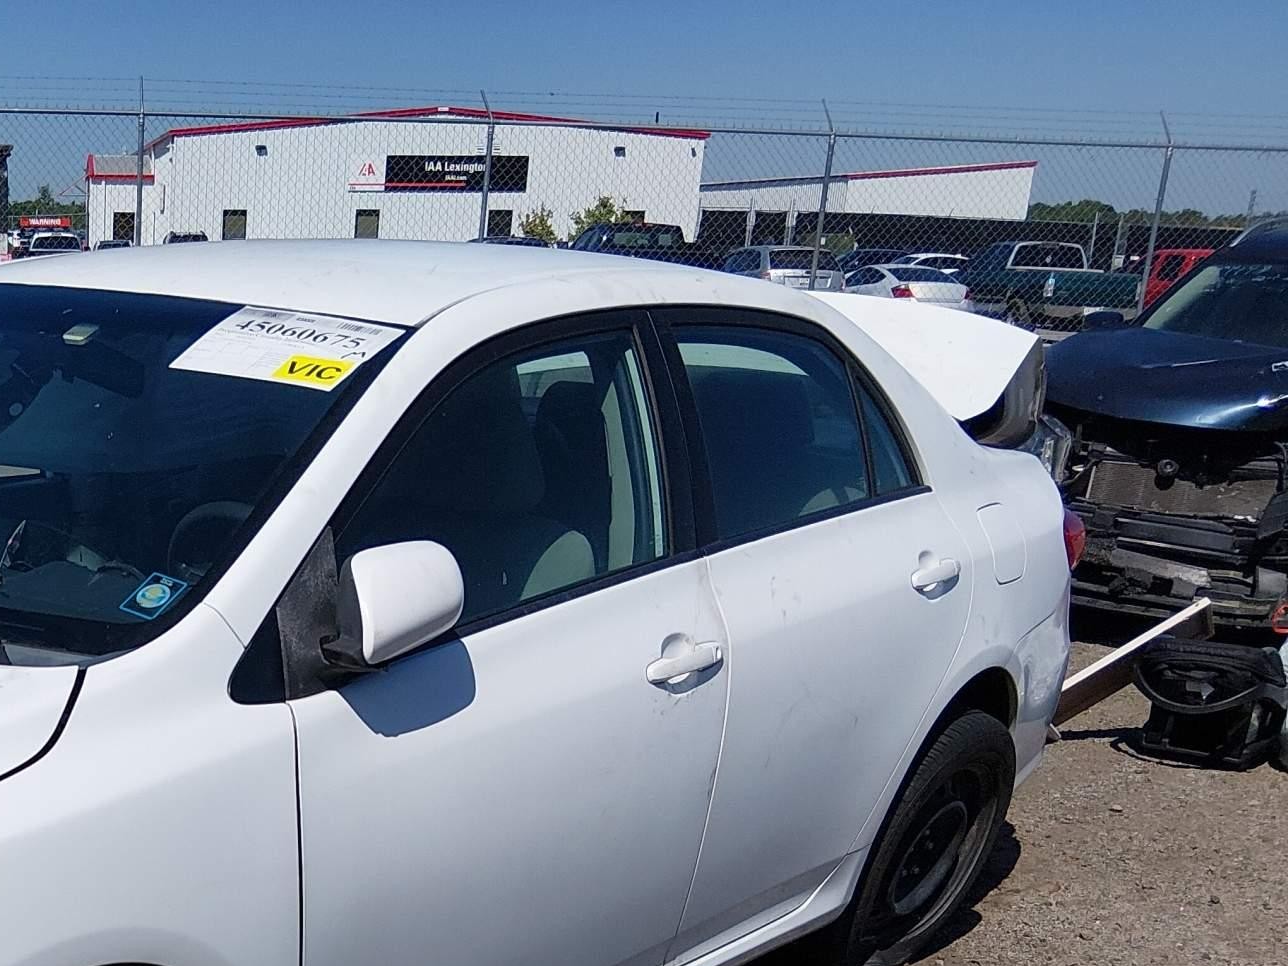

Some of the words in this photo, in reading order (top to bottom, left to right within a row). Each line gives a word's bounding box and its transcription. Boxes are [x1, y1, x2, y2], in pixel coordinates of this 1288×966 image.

[424, 161, 442, 172] IAA
[28, 218, 62, 226] WARNING
[235, 318, 367, 350] 45060675
[287, 360, 342, 381] VIC
